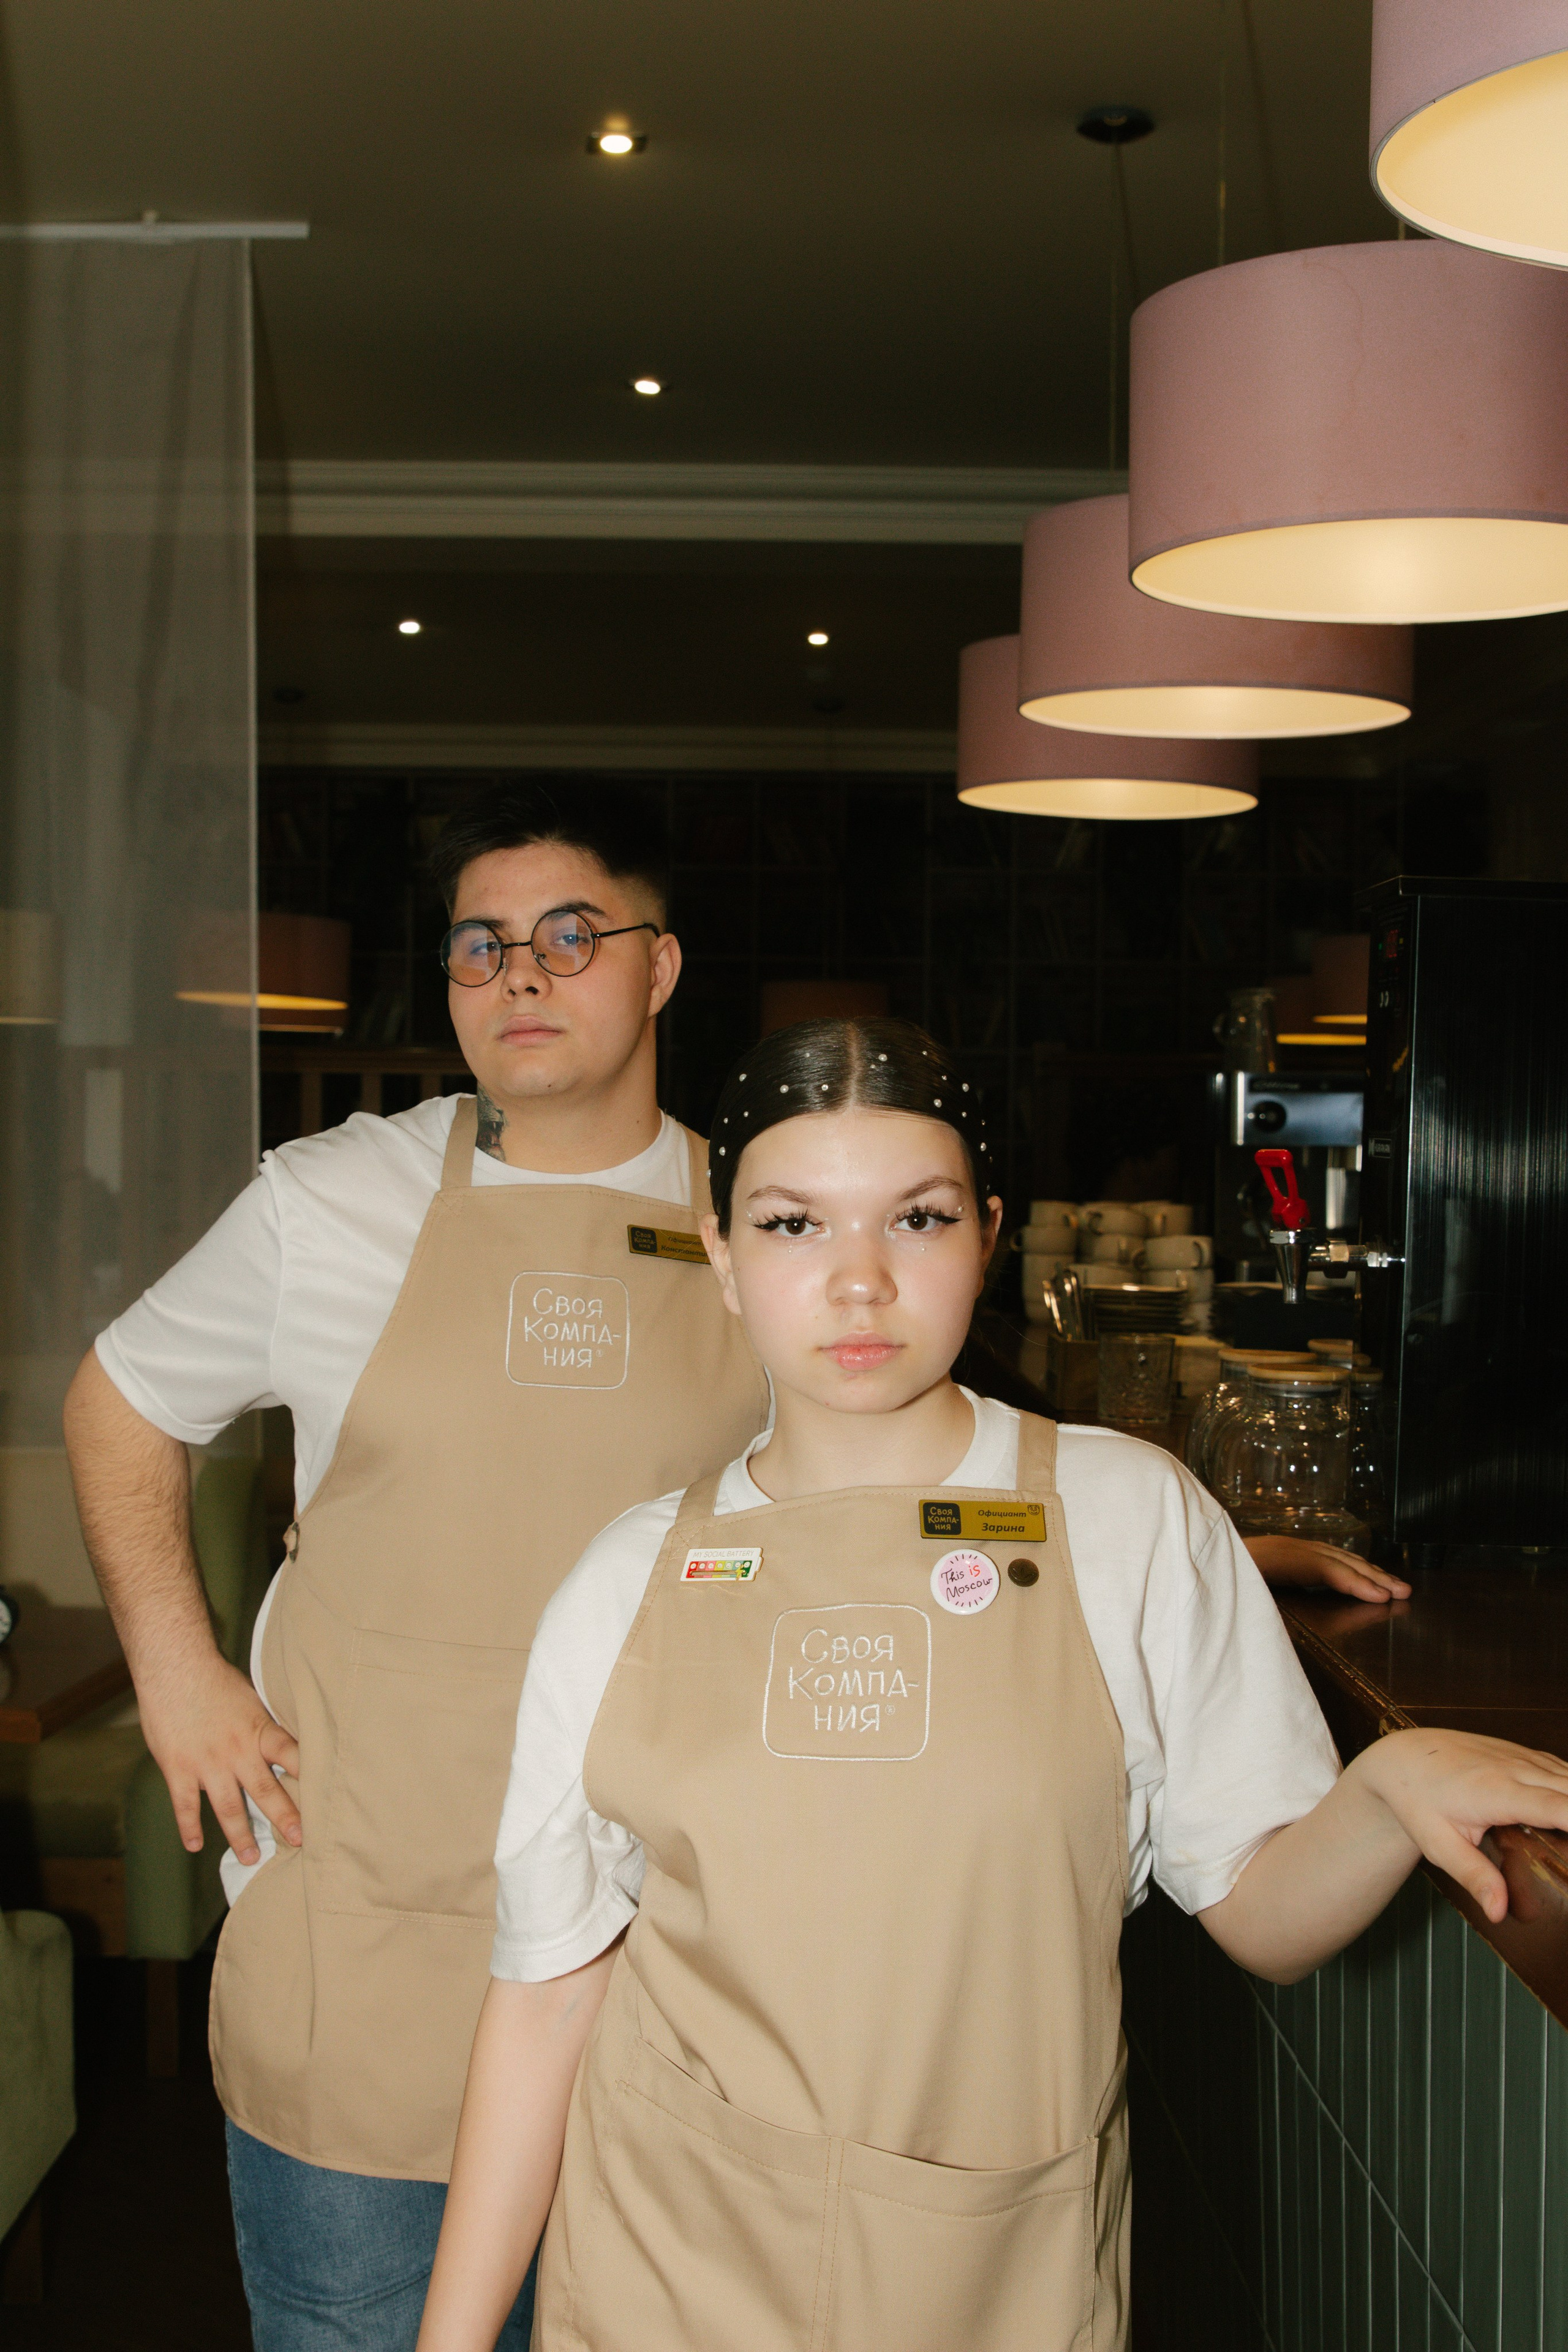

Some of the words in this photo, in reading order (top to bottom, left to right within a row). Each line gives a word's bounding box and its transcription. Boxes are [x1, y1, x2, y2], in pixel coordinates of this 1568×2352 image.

[533, 1287, 603, 1318] Своя
[930, 1507, 952, 1516] Своя
[978, 1509, 1027, 1518] Официант
[981, 1523, 1025, 1533] Зарина
[941, 1568, 965, 1585] This
[968, 1564, 981, 1578] is
[946, 1578, 993, 1602] Moscow
[801, 1628, 894, 1664] Своя
